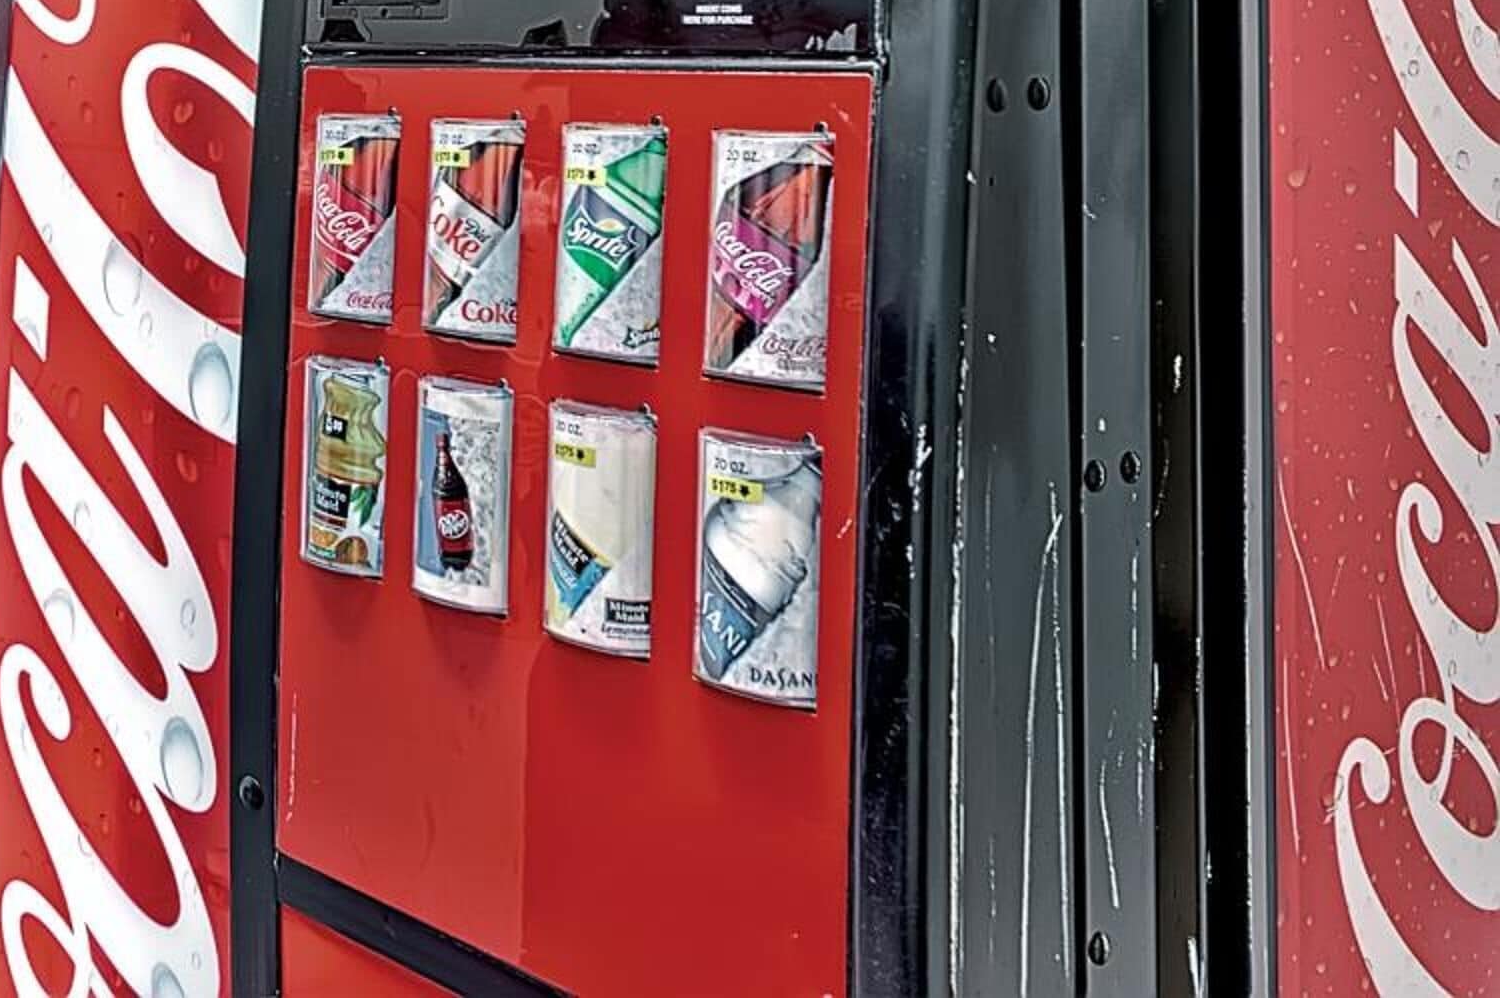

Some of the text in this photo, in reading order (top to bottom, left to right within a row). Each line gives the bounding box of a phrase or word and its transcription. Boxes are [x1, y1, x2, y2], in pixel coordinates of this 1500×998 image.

[568, 216, 629, 259] Sprite
[714, 221, 796, 294] Coca-Cola
[460, 299, 518, 326] Coke
